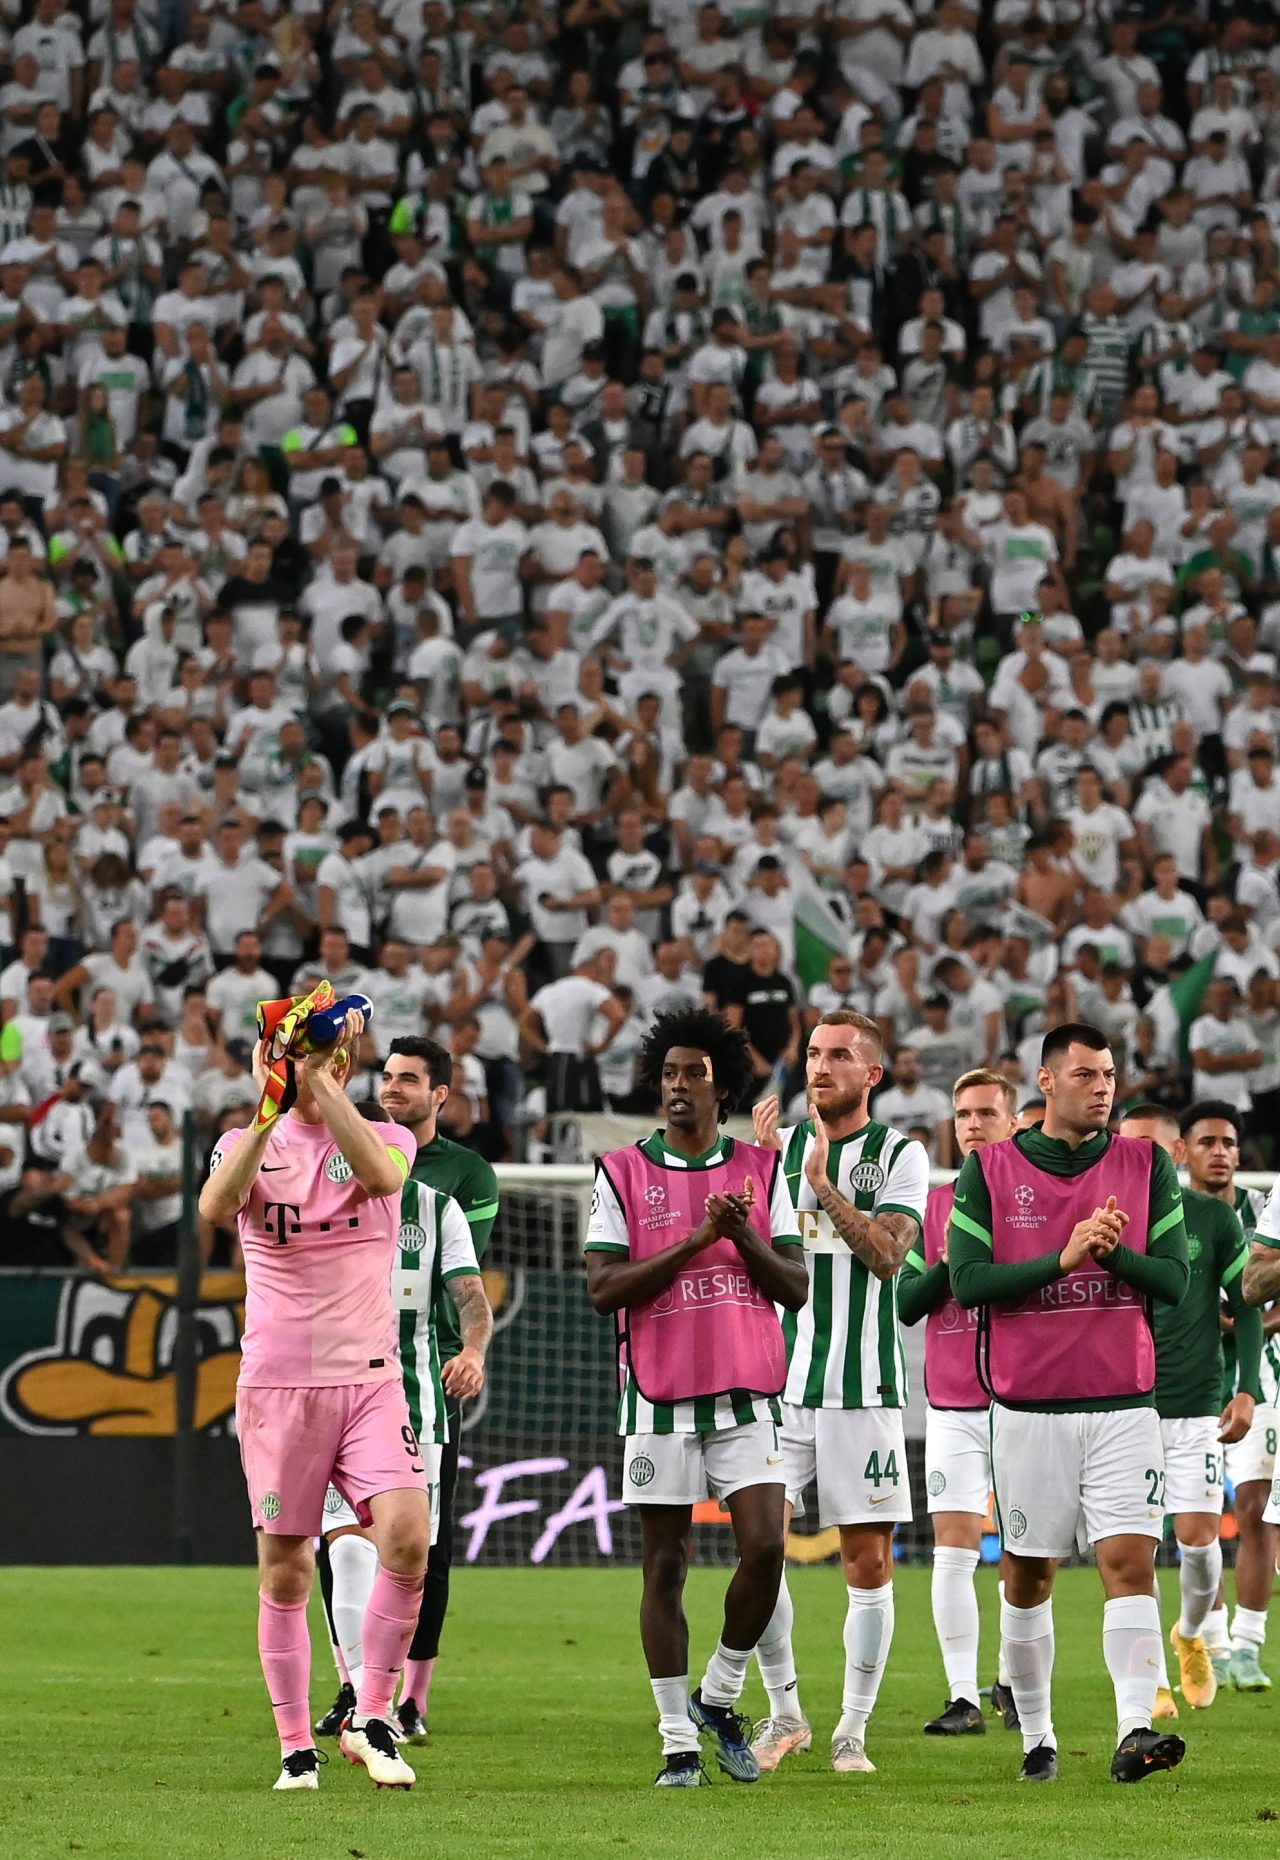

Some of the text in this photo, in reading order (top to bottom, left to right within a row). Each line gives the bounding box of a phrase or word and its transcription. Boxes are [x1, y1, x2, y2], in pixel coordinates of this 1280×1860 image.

[264, 1202, 300, 1245] T
[638, 1210, 682, 1226] CHAMPIONS
[647, 1218, 675, 1231] LEAGUE
[1005, 1215, 1048, 1223] CHAMPIONS
[680, 1273, 760, 1302] RESPE
[1041, 1279, 1142, 1306] RESPEC
[1265, 1427, 1277, 1455] 8
[864, 1449, 900, 1487] 44
[457, 1455, 631, 1563] FA
